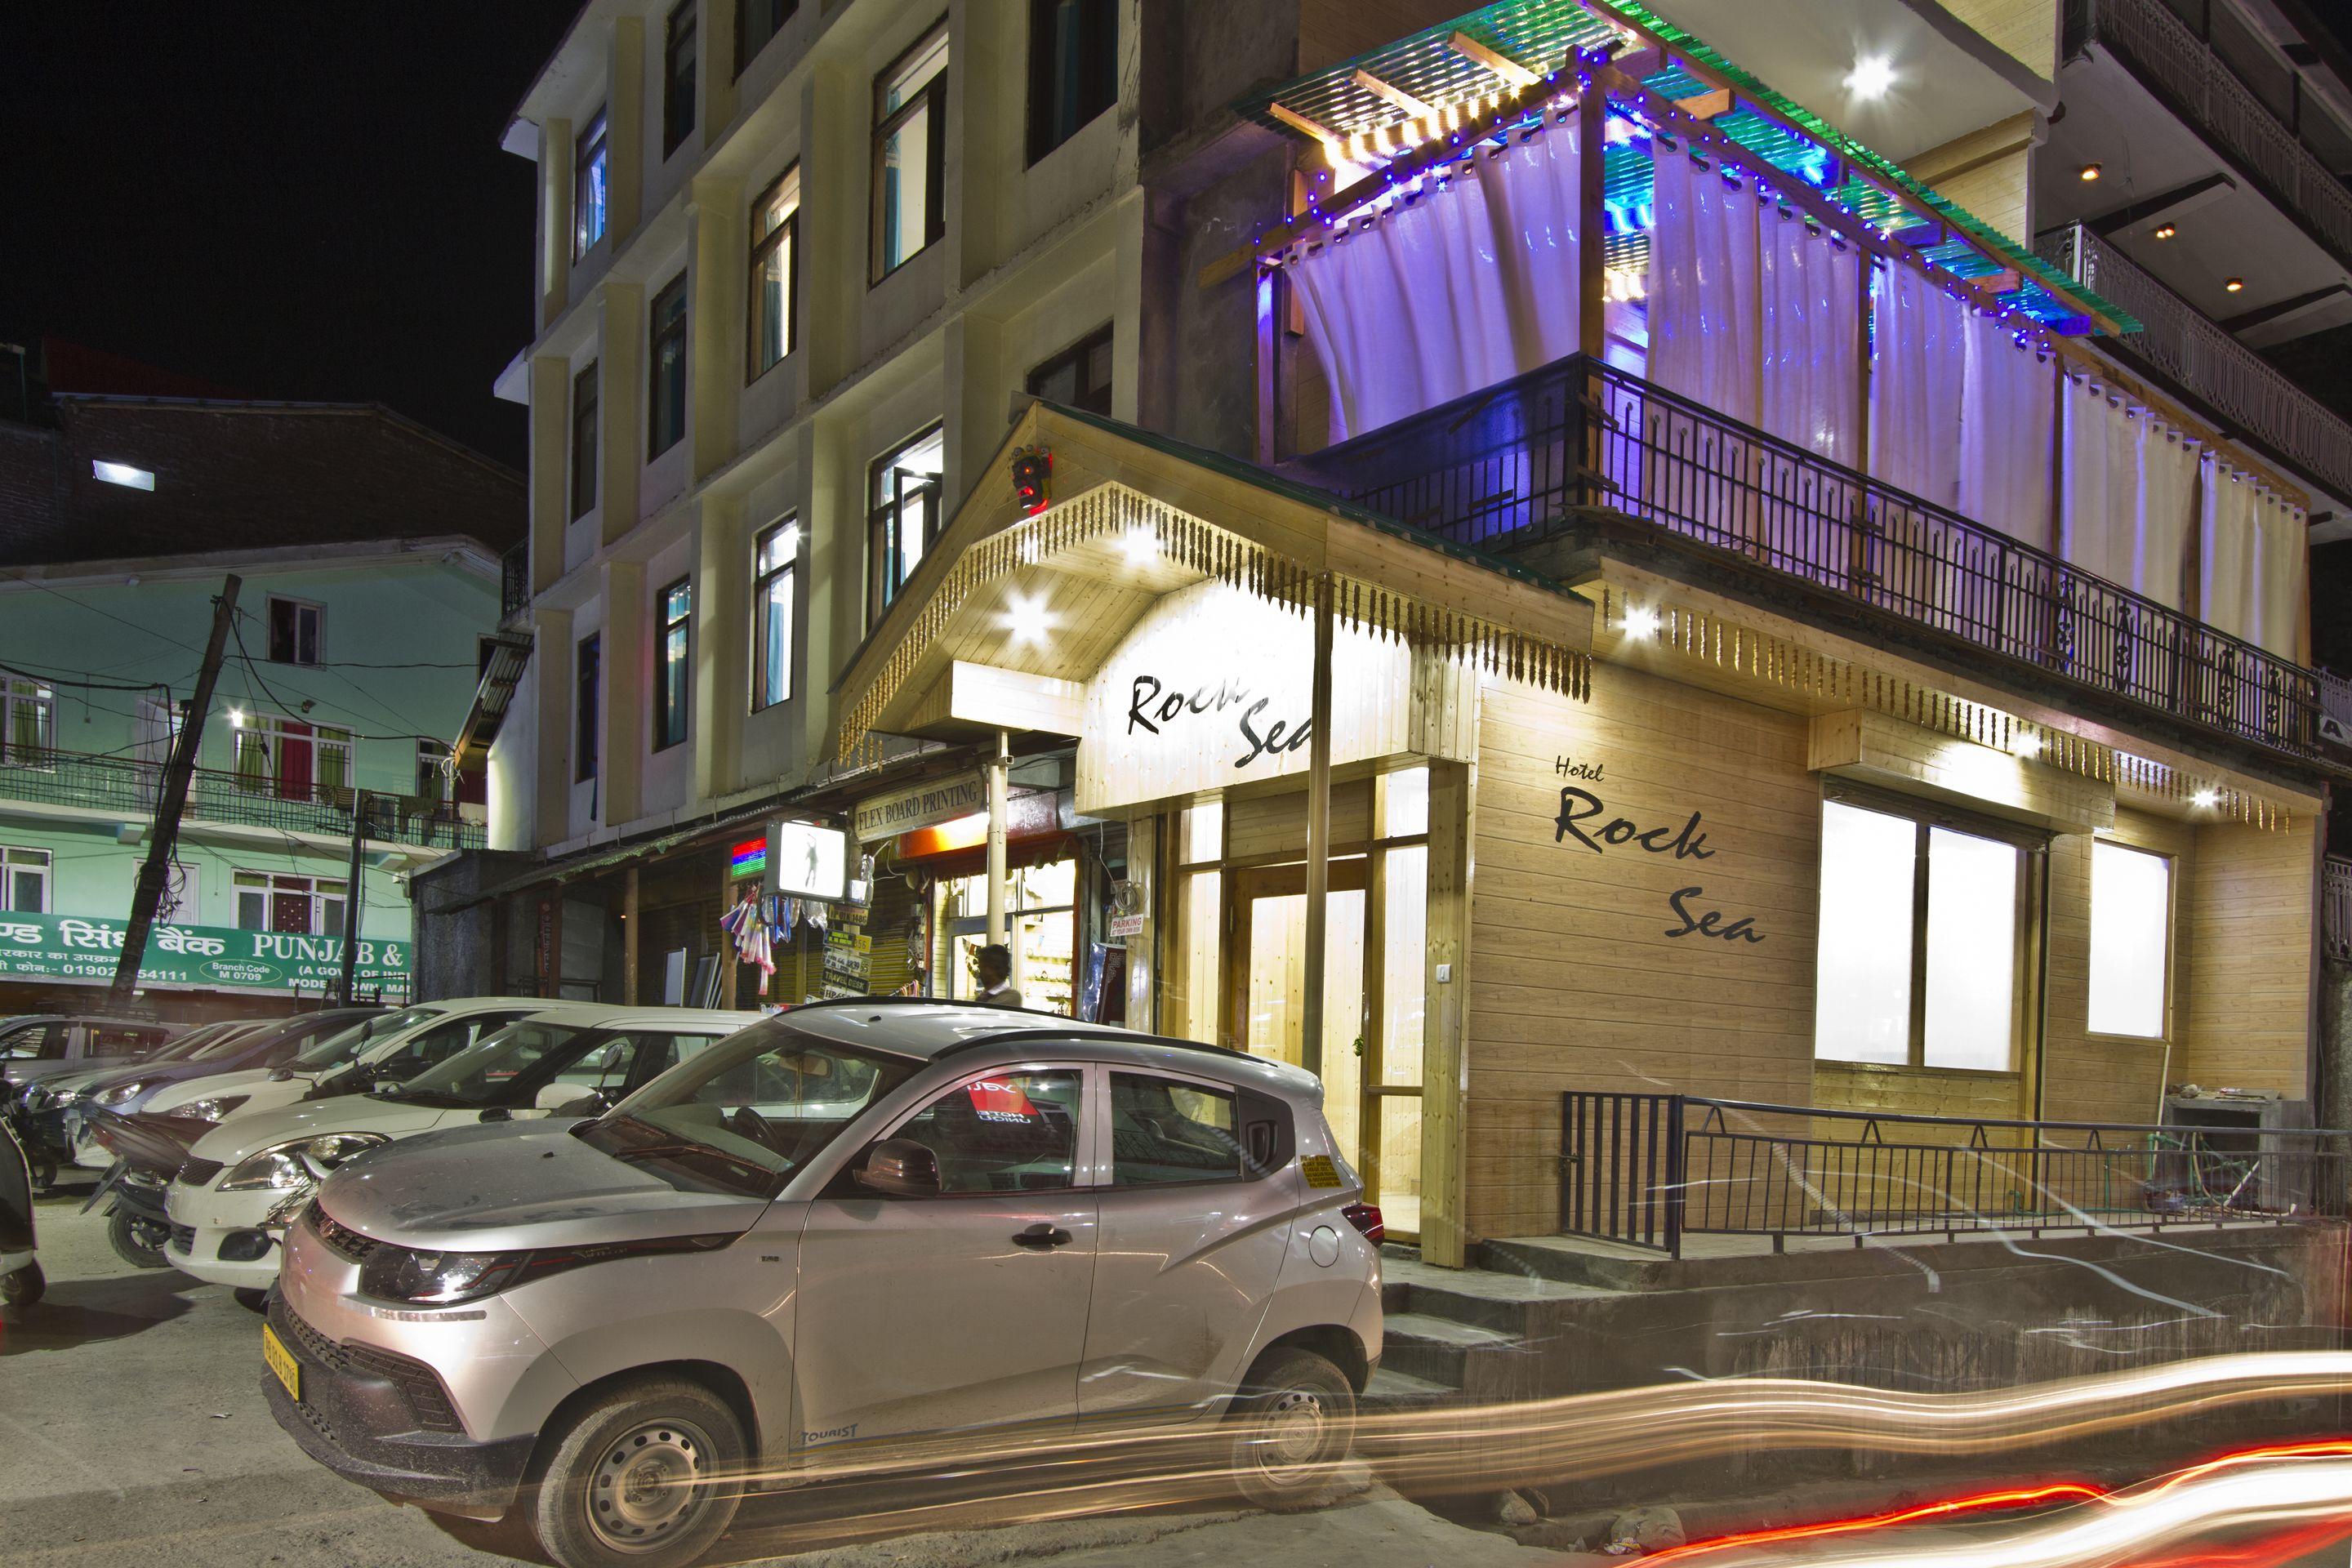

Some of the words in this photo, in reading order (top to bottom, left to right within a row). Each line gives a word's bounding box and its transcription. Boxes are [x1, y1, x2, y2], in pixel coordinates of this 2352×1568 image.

[1128, 675, 1250, 736] Rock
[1234, 697, 1312, 768] Sea
[1555, 755, 1605, 782] Hotel
[858, 807, 883, 831] FLEX
[885, 797, 920, 824] BOARD
[923, 781, 977, 814] PRINTING
[1554, 786, 1716, 860] Rock
[1112, 917, 1142, 929] PARKING
[1664, 886, 1766, 943] Sea
[212, 962, 244, 972] Branch
[247, 964, 270, 973] Code
[382, 943, 404, 967] &
[233, 972, 261, 981] 0709
[288, 978, 327, 989] MODE
[800, 1423, 859, 1446] TOURIST
